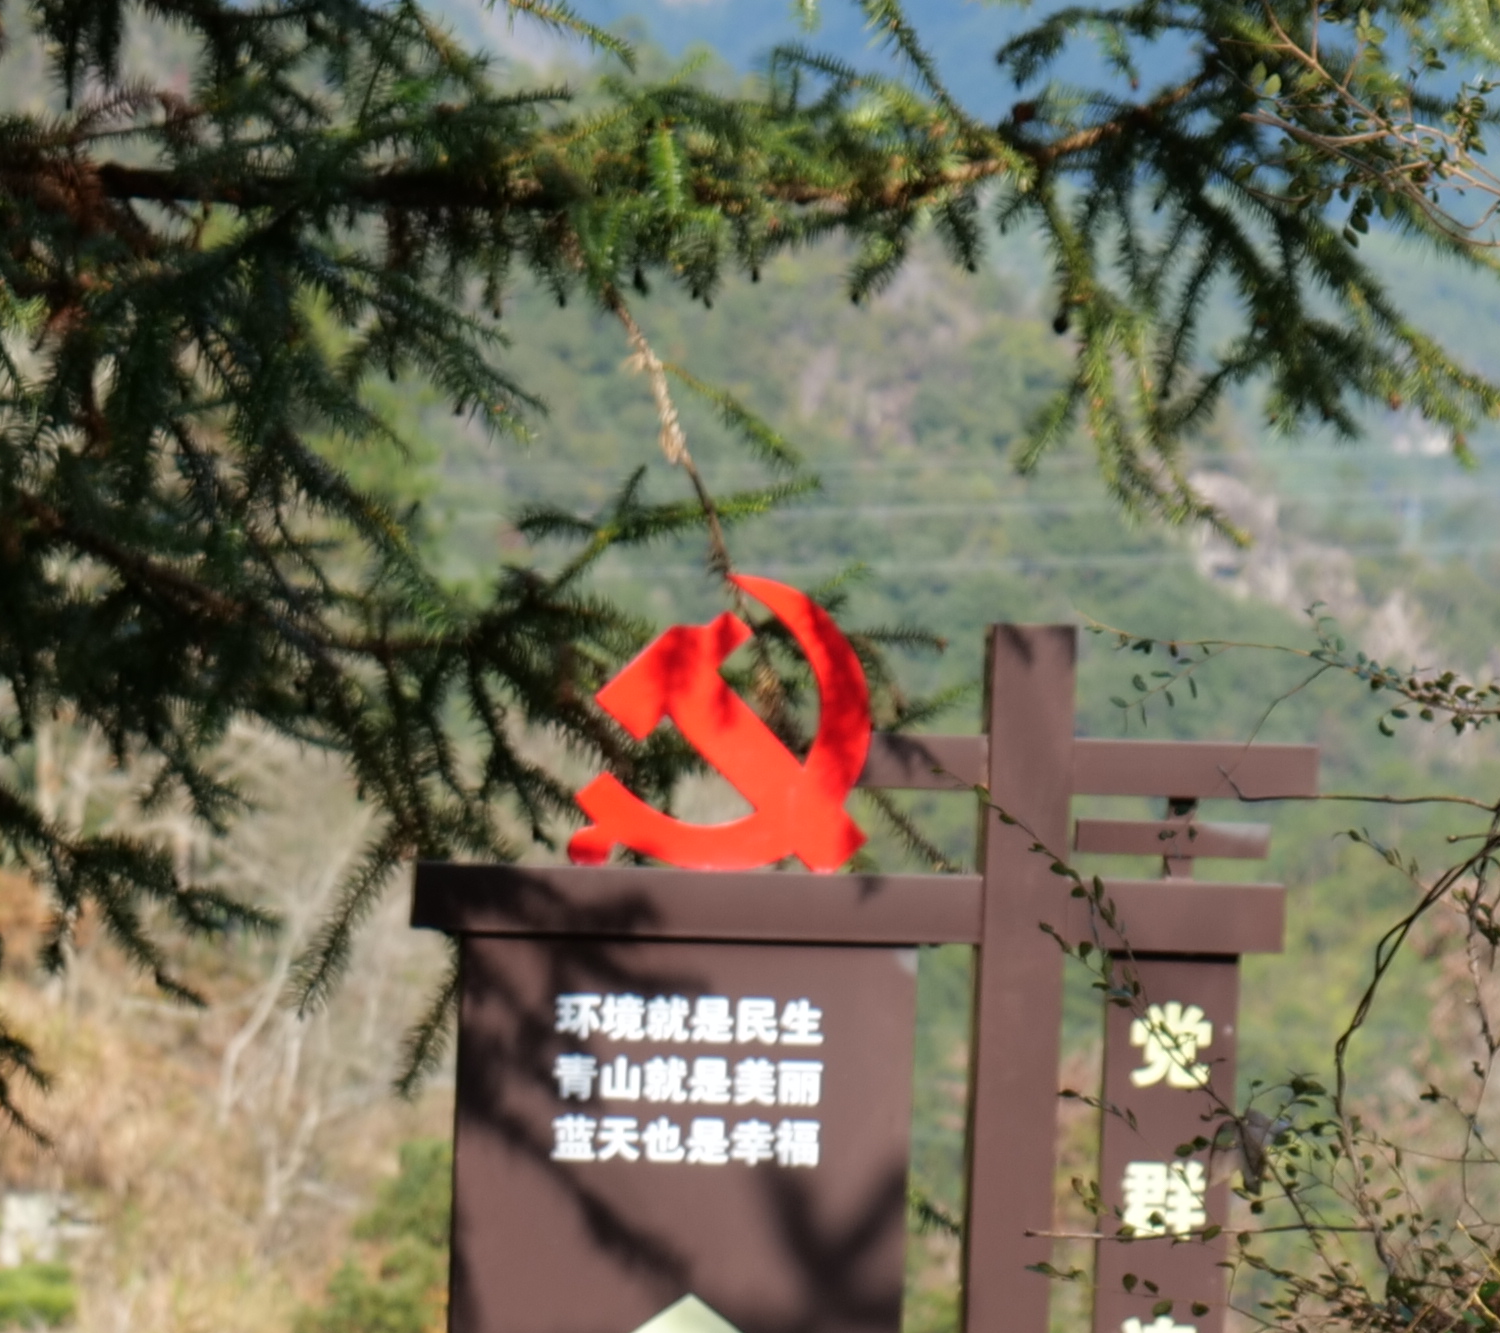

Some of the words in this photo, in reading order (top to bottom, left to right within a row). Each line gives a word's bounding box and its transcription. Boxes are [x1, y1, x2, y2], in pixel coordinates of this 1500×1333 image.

[555, 992, 824, 1045] 环境就是民生
[553, 1053, 824, 1107] 青山就是美丽
[551, 1113, 821, 1168] 蓝天也是幸福
